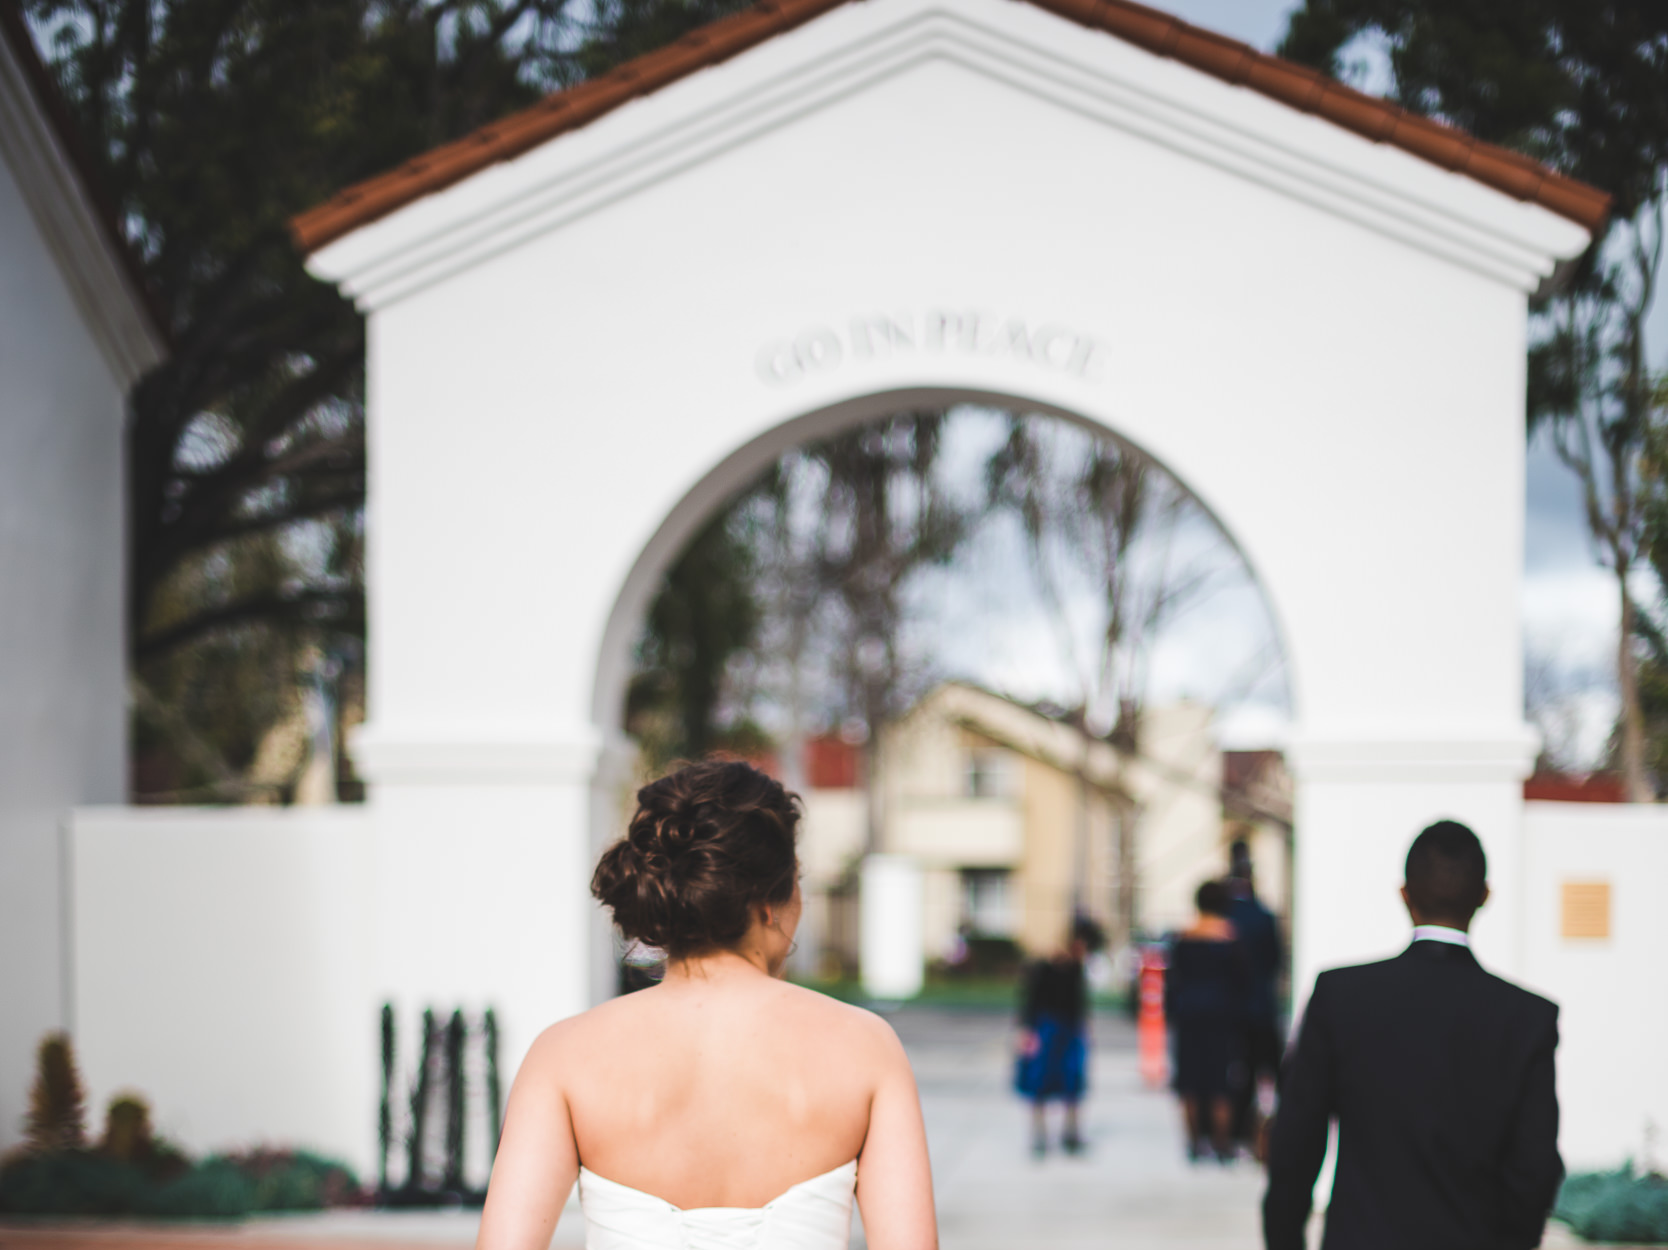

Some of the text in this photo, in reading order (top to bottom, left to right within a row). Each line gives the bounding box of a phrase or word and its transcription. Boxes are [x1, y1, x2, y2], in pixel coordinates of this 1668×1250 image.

[755, 307, 1109, 387] GO IN PEACE
